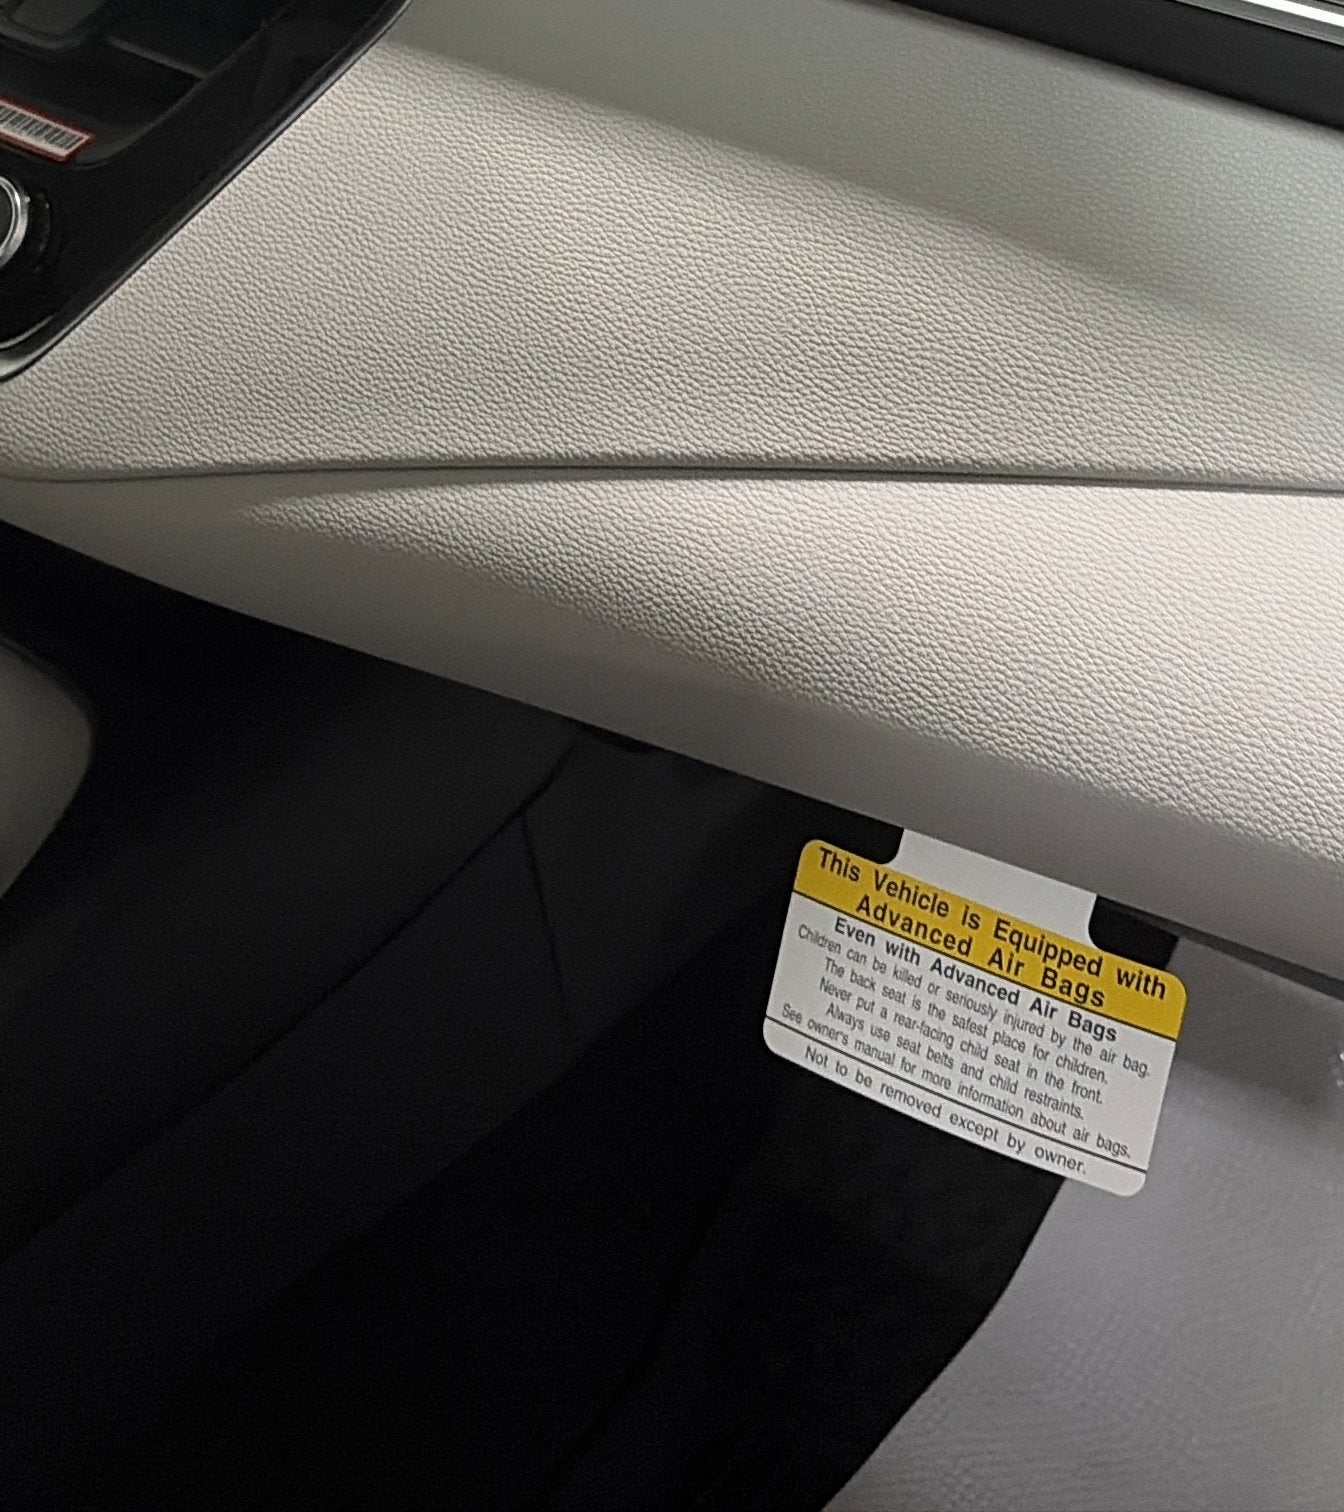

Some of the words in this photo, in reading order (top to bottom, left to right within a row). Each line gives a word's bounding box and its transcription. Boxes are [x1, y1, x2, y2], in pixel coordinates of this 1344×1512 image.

[819, 846, 861, 882] This
[874, 869, 950, 918] Vehicle
[961, 905, 981, 930] is
[994, 917, 1103, 977] Equipped
[1116, 967, 1166, 1000] with
[834, 916, 876, 947] Even
[885, 939, 921, 966] with
[930, 957, 1021, 1006] Advanced
[1029, 996, 1058, 1020] Air
[1068, 1010, 1118, 1042] Bags
[856, 894, 973, 957] Advanced
[987, 947, 1025, 977] Air
[1041, 966, 1105, 1007] Bags
[798, 924, 841, 954] Children
[846, 948, 867, 965] can
[872, 956, 887, 973] be
[892, 966, 922, 988] killed
[927, 982, 940, 995] or
[945, 989, 998, 1022] seriously
[1003, 1010, 1045, 1038] injured
[1050, 1028, 1067, 1049] by
[1072, 1037, 1093, 1056] the
[1099, 1046, 1118, 1064] air
[1123, 1054, 1151, 1079] bag.
[819, 976, 852, 1002] Never
[856, 997, 875, 1014] put
[879, 1007, 888, 1019] a
[893, 1012, 955, 1050] rear-facing
[959, 1039, 989, 1061] child
[994, 1053, 1021, 1074] seat
[1026, 1064, 1038, 1080] in
[1044, 1071, 1065, 1090] the
[1071, 1080, 1103, 1105] front.
[825, 956, 845, 978] The
[850, 969, 875, 989] back
[881, 985, 907, 1005] seat
[911, 994, 922, 1011] is
[927, 1002, 946, 1021] the
[952, 1013, 988, 1039] safest
[992, 1030, 1026, 1054] place
[1032, 1043, 1050, 1061] for
[825, 1002, 865, 1032] Always
[870, 1025, 891, 1041] use
[896, 1035, 922, 1056] seat
[926, 1045, 954, 1070] belts
[960, 1061, 984, 1081] and
[988, 1073, 1018, 1096] child
[1023, 1088, 1084, 1121] restraints.
[782, 1003, 803, 1025] See
[807, 1018, 849, 1046] owner's
[854, 1039, 896, 1065] manual
[900, 1057, 917, 1075] for
[921, 1069, 952, 1090] more
[957, 1080, 1024, 1120] information
[1030, 1111, 1067, 1136] about
[1072, 1127, 1090, 1144] air
[1096, 1134, 1132, 1159] bags.
[805, 1045, 829, 1069] Not
[835, 1061, 848, 1077] to
[855, 1069, 873, 1088] be
[880, 1082, 943, 1118] removed
[949, 1112, 999, 1143] except
[1006, 1132, 1026, 1156] by
[1034, 1146, 1087, 1175] owner.
